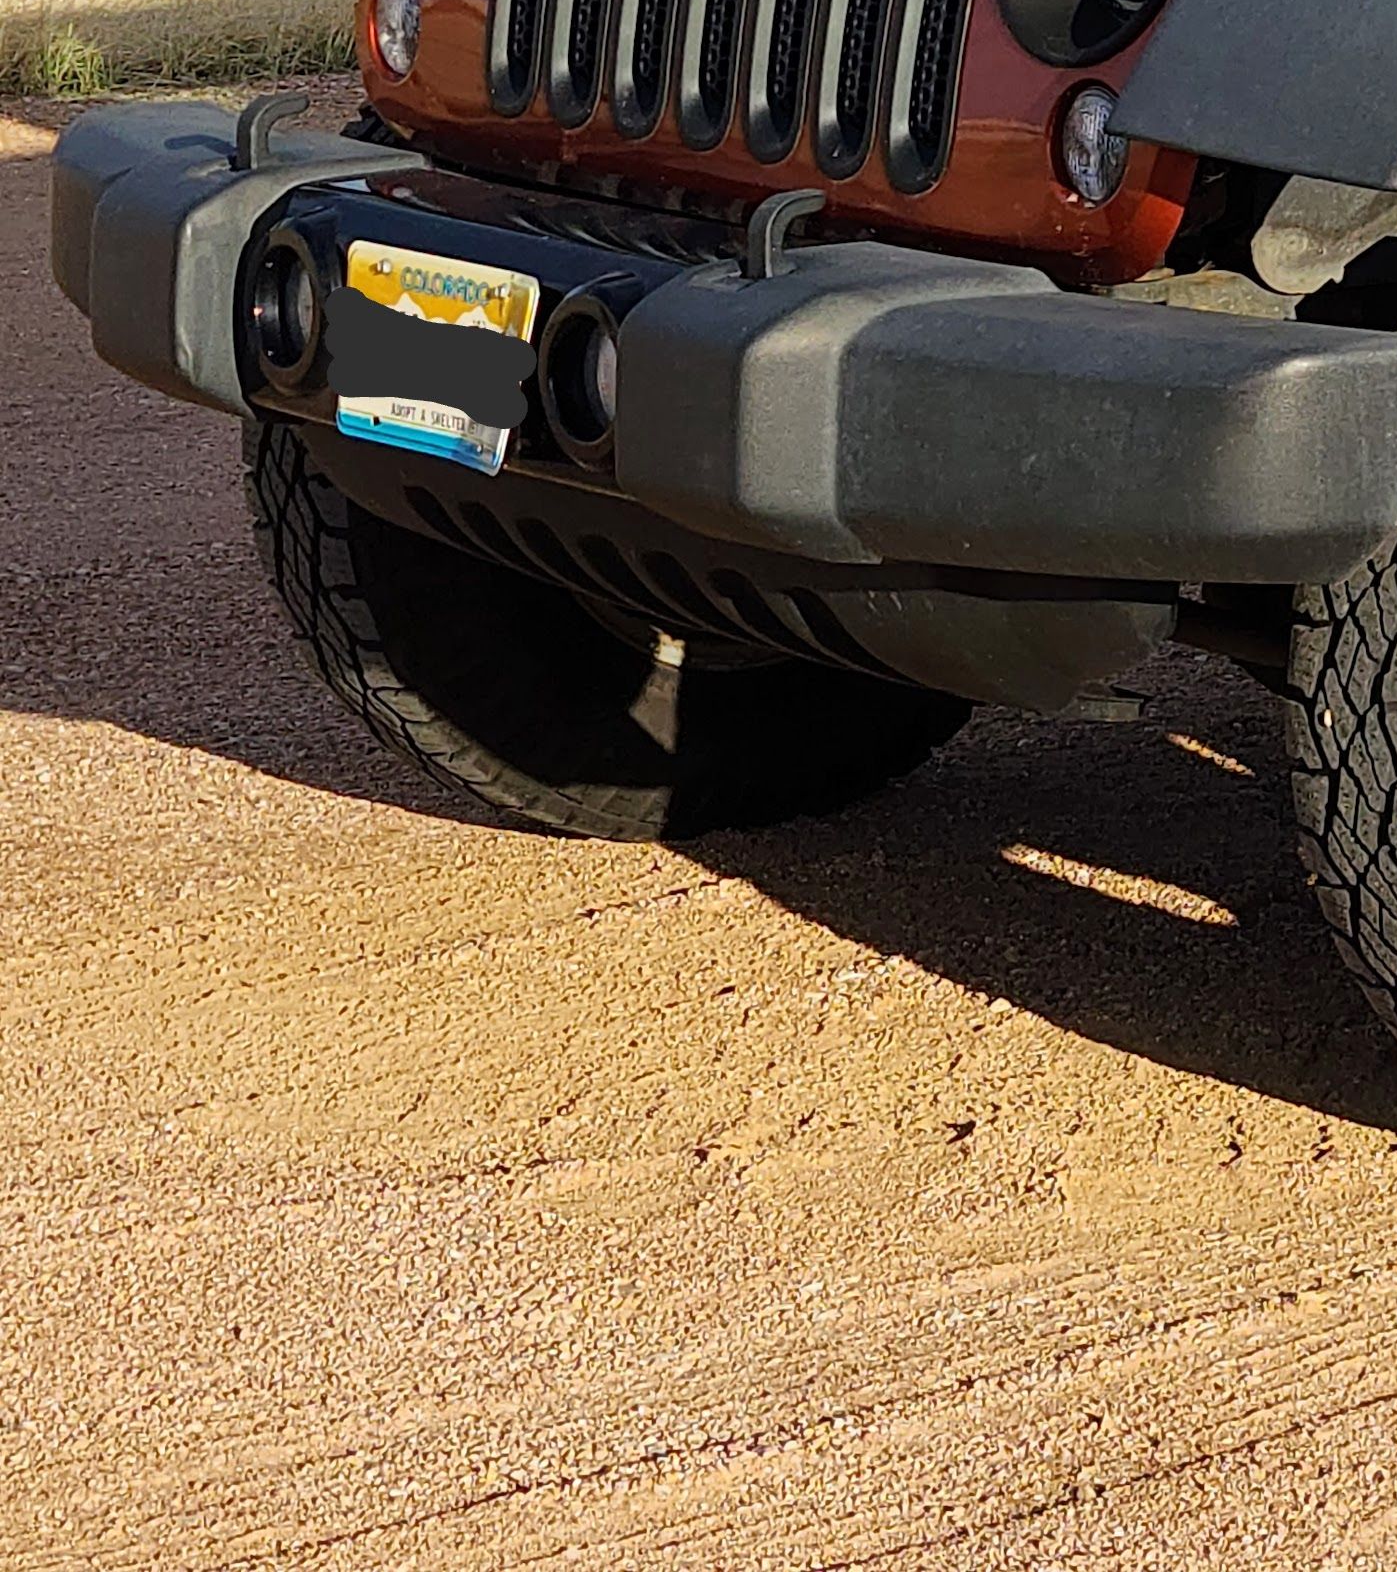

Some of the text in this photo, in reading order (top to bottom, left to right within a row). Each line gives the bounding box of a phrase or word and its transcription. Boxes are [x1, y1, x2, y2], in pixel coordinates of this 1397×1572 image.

[401, 266, 490, 307] COLORADO
[391, 402, 416, 420] ADOPT
[420, 408, 427, 421] A
[431, 410, 466, 431] SHELTER
